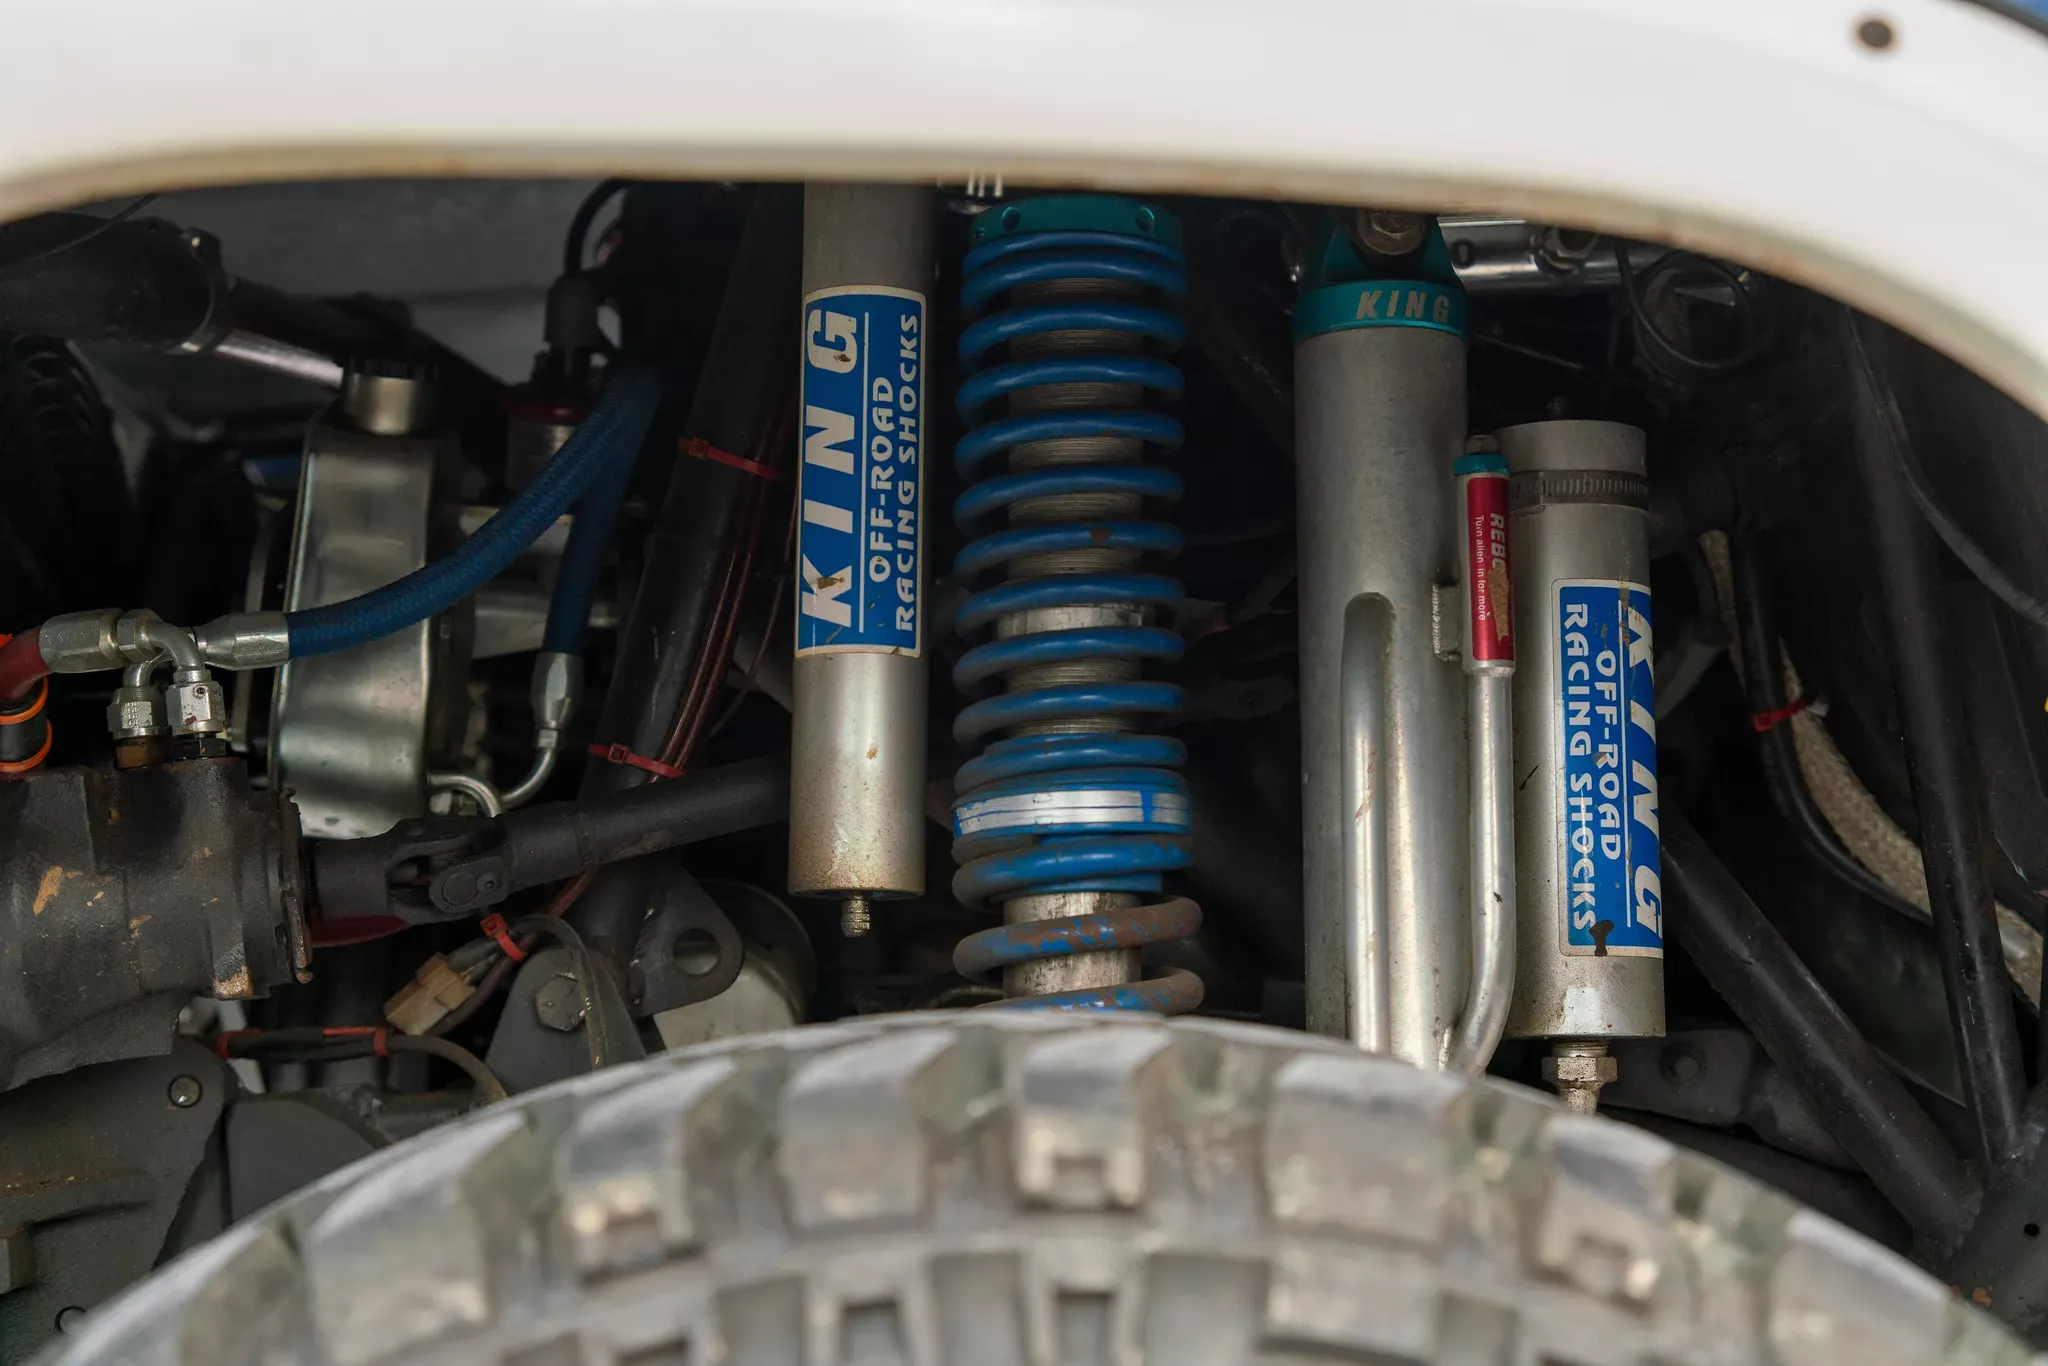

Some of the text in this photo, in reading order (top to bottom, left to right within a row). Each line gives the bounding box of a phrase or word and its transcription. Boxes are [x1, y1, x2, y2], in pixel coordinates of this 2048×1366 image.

[1356, 289, 1450, 324] KING
[801, 308, 858, 628] KING
[868, 376, 894, 583] OFF-ROAD
[895, 313, 919, 632] RACING SHOCKS
[1475, 514, 1487, 621] Turn allen in for more
[1564, 603, 1597, 930] RACING SHOCKS
[1594, 649, 1621, 860] OFF-ROAD
[1627, 605, 1664, 940] KING
